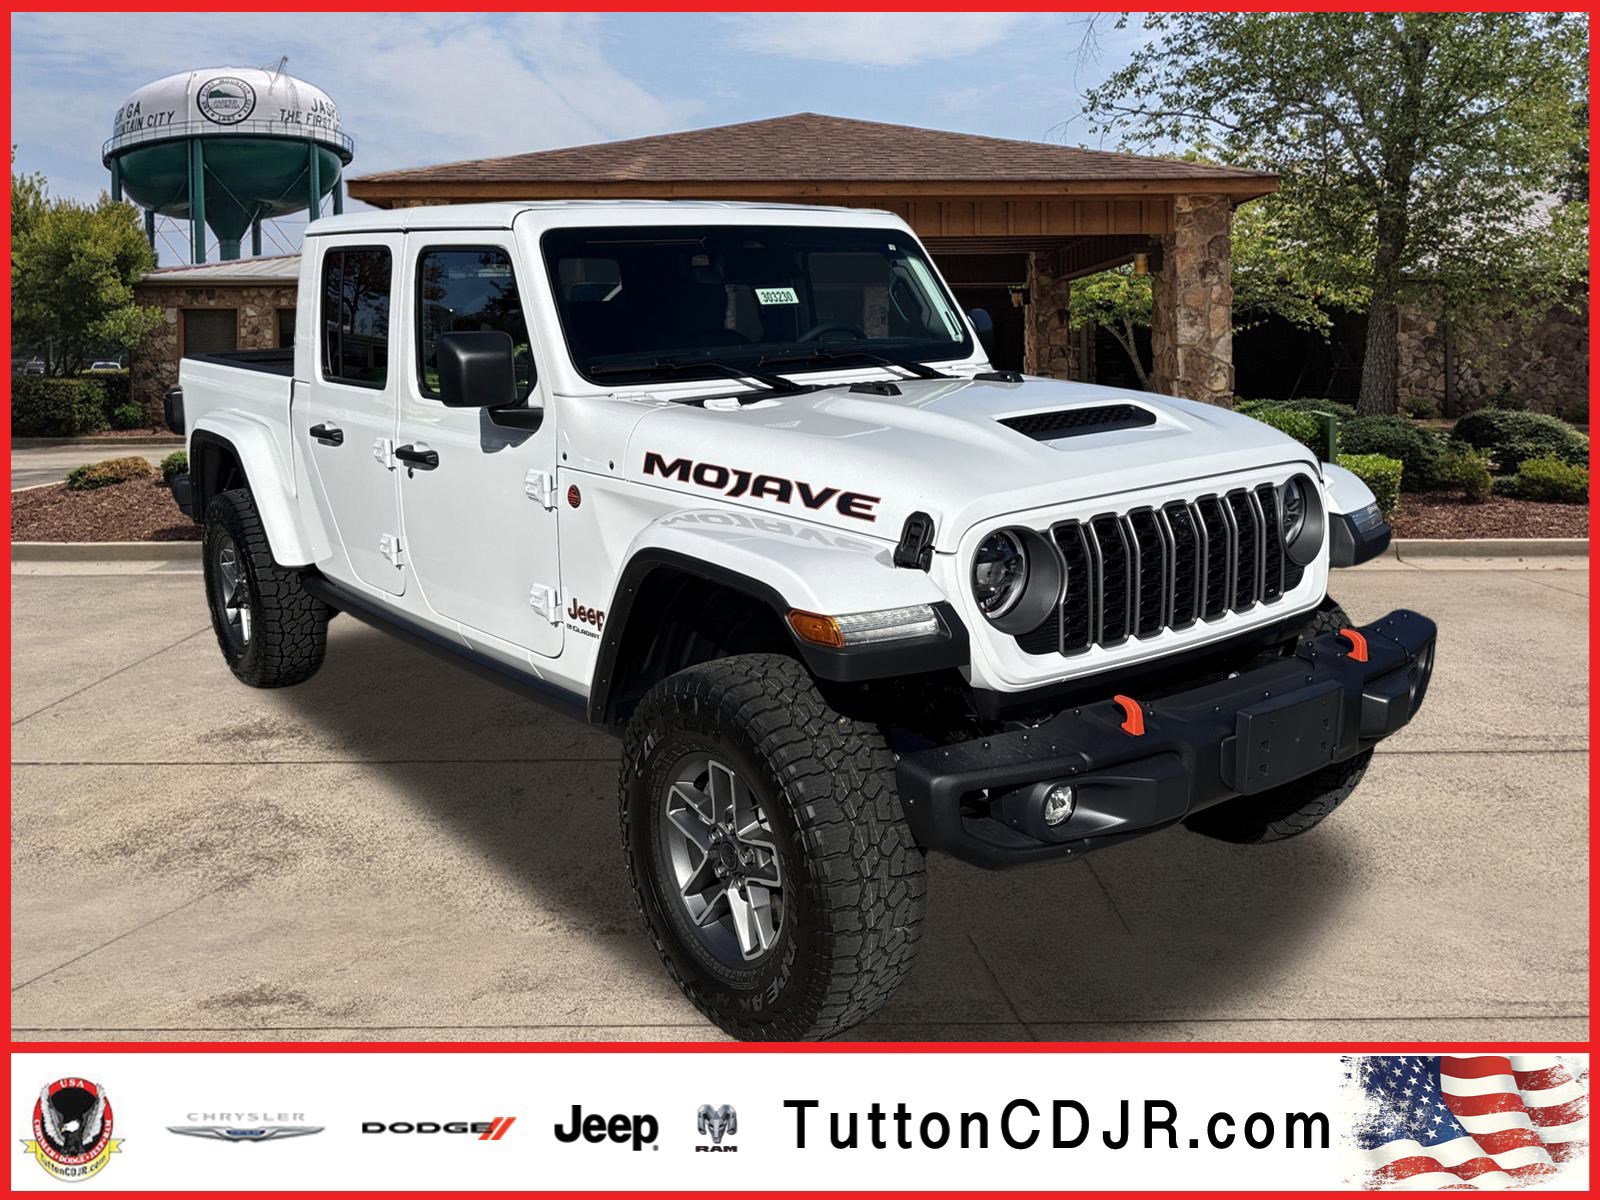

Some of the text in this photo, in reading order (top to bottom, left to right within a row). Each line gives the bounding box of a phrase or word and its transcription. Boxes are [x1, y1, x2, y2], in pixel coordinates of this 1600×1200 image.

[126, 100, 141, 119] GA
[147, 110, 175, 128] CITY
[280, 108, 302, 124] THE
[306, 112, 332, 129] FIRST
[760, 290, 793, 304] 303230
[642, 451, 882, 523] MOJAVE
[567, 597, 606, 632] Jeep
